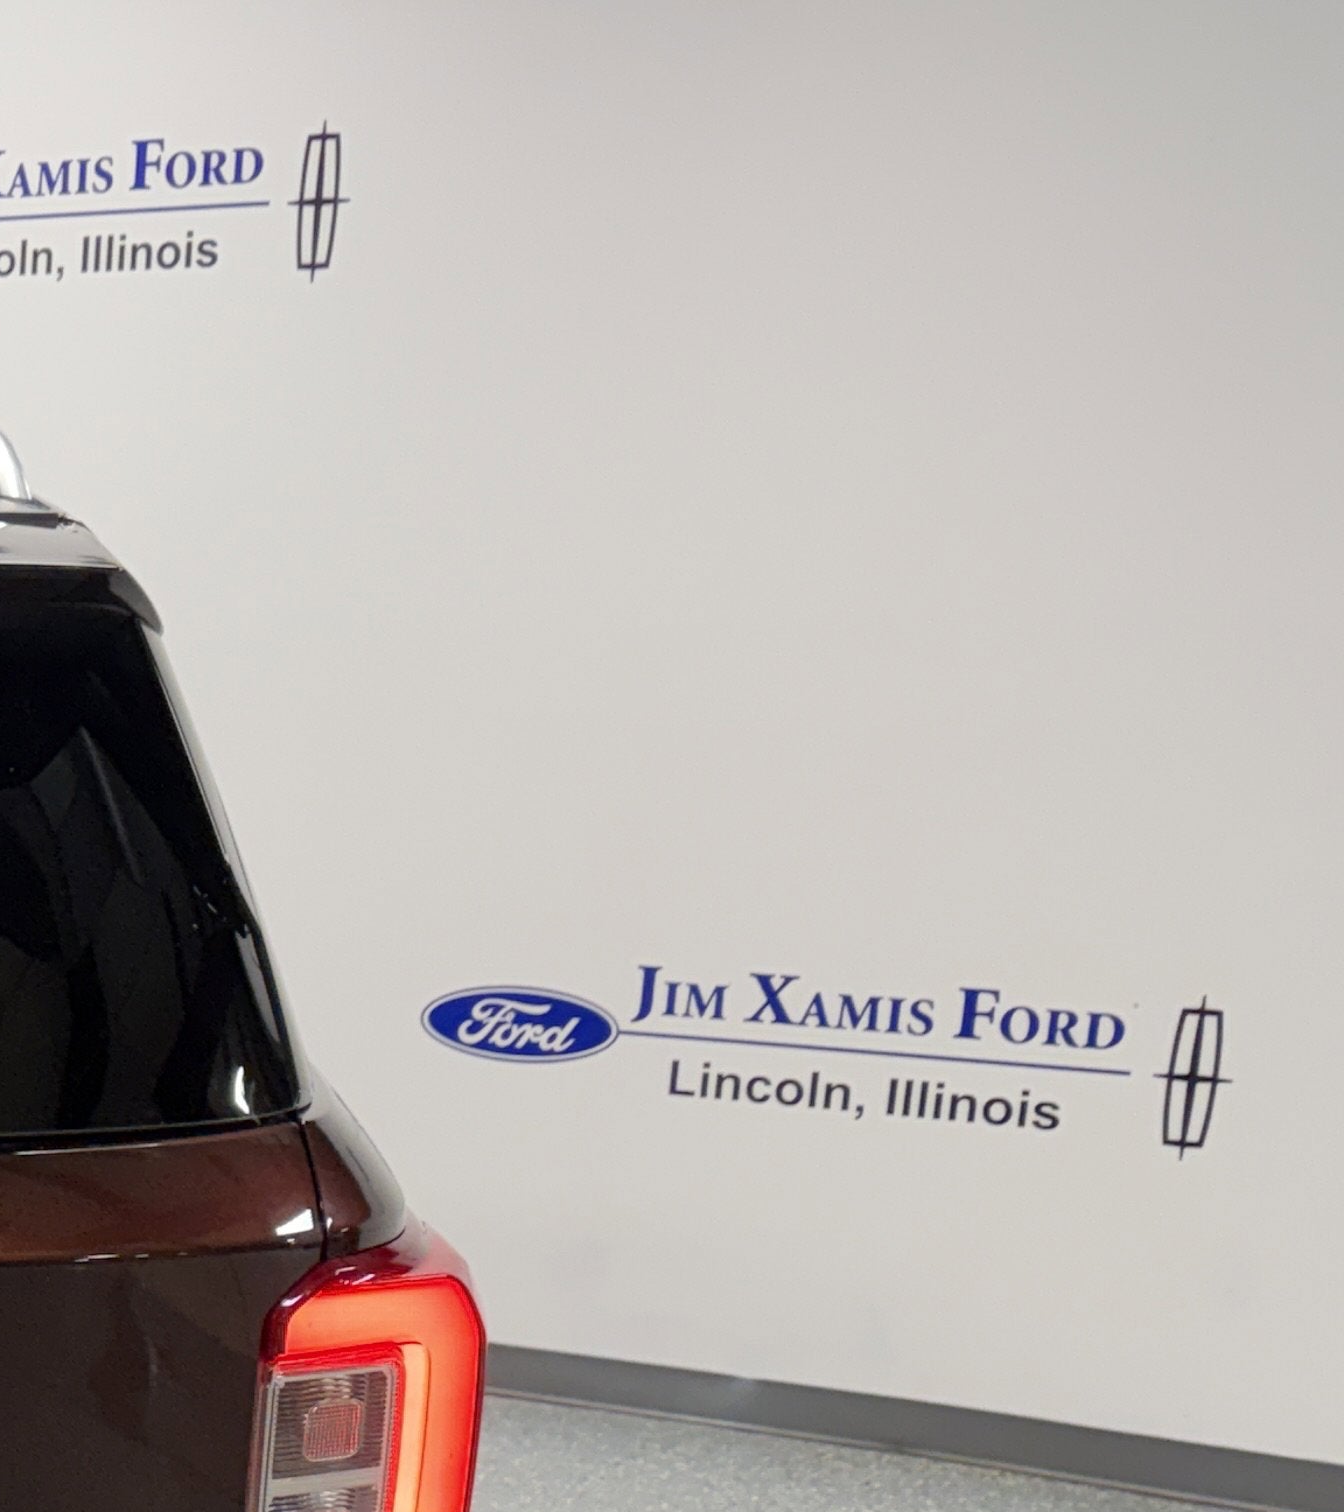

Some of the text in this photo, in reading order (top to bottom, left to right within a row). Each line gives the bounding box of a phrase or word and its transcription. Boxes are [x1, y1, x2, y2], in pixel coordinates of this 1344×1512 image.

[129, 138, 263, 192] FORD
[81, 230, 218, 274] Illinois
[456, 999, 579, 1055] Ford
[630, 965, 1126, 1051] JIM XAMIS FORD
[668, 1061, 1061, 1131] Lincoln, Illinois
